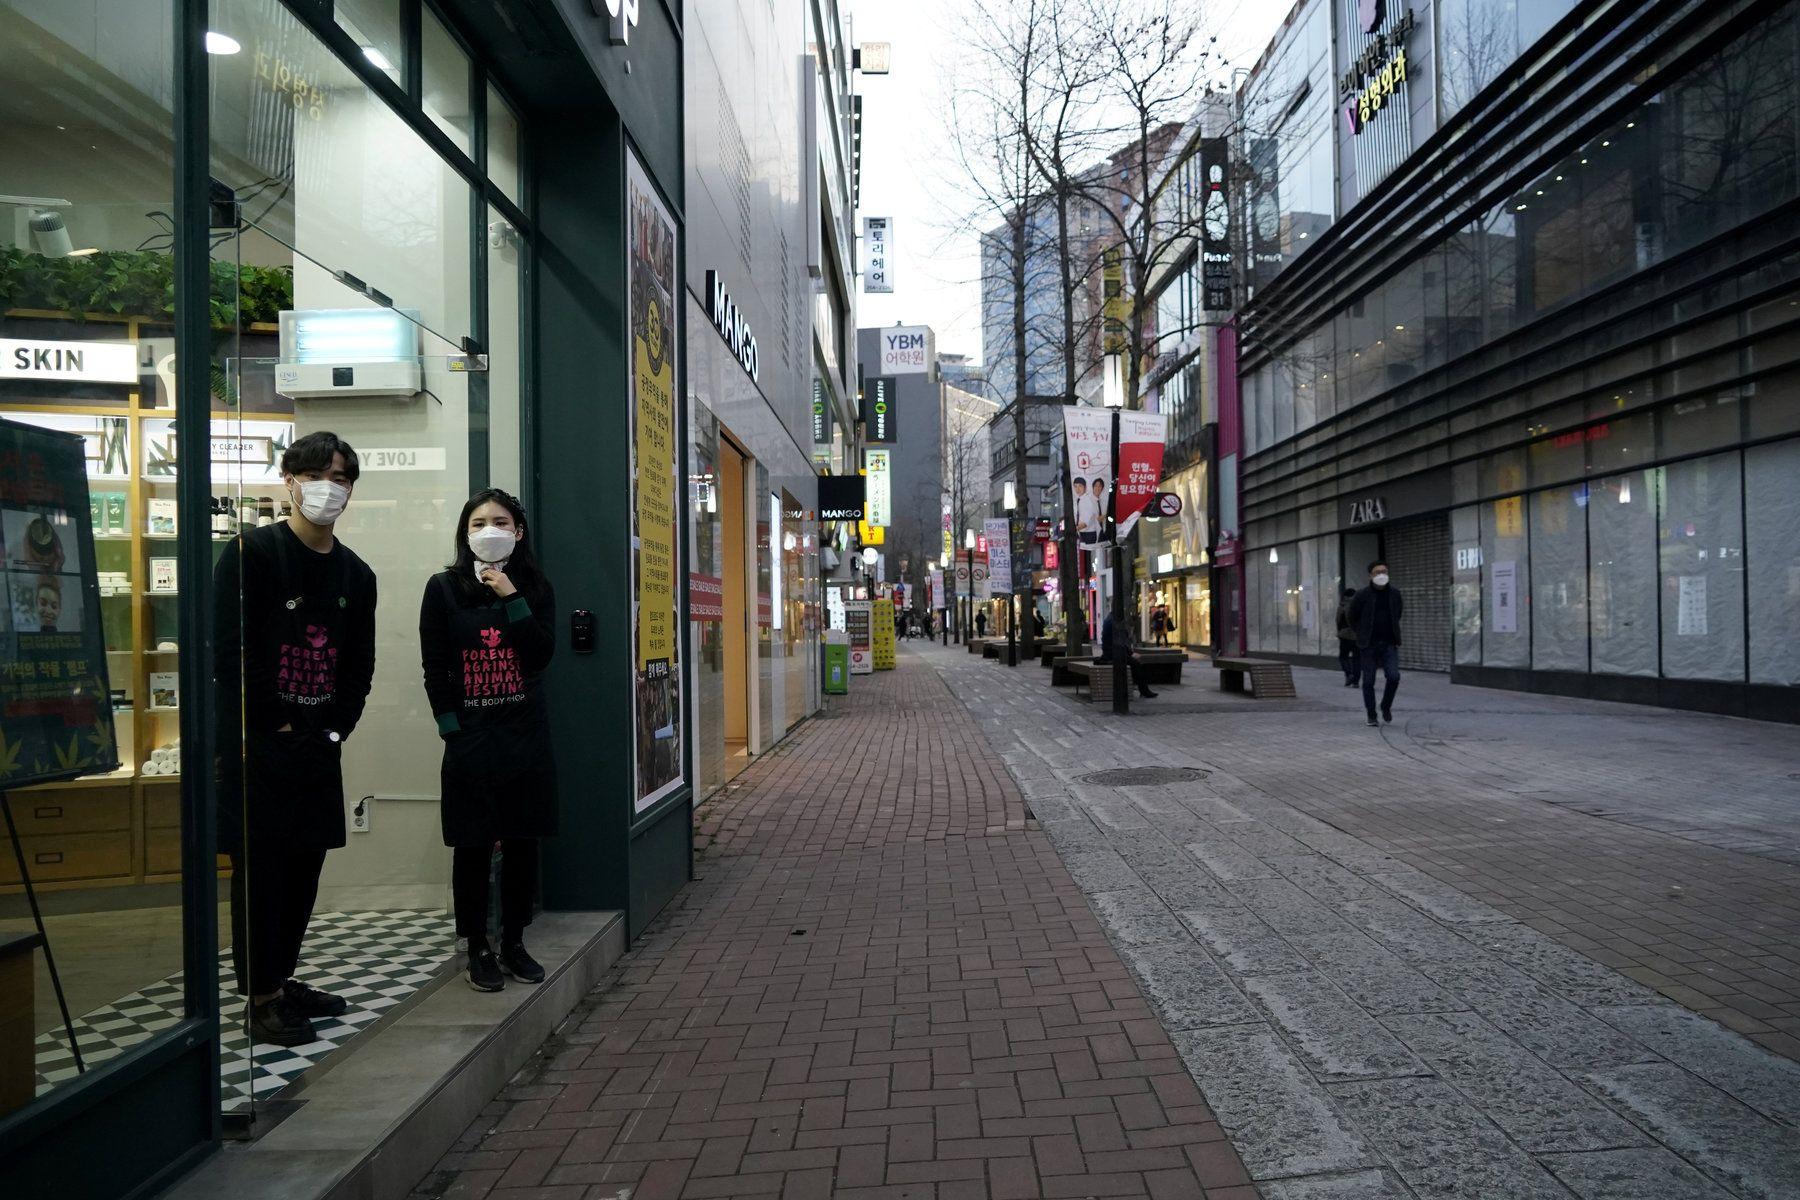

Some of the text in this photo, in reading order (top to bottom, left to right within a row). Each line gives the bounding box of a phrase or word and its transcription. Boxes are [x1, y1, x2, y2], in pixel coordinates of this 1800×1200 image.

[872, 231, 884, 283] 토리헤어
[714, 269, 759, 383] MANGO
[887, 334, 924, 350] YBM
[14, 347, 84, 372] SKIN
[886, 350, 924, 365] 어학원
[877, 380, 885, 439] OLIVE YOUNG
[1129, 474, 1156, 483] 당신이
[1120, 485, 1157, 494] 필요합니
[822, 510, 861, 518] MANGO
[1350, 498, 1385, 525] ZARA
[463, 648, 516, 660] FOREVE
[464, 671, 521, 685] ANIMAL
[464, 699, 479, 707] THE
[482, 697, 505, 707] BODY
